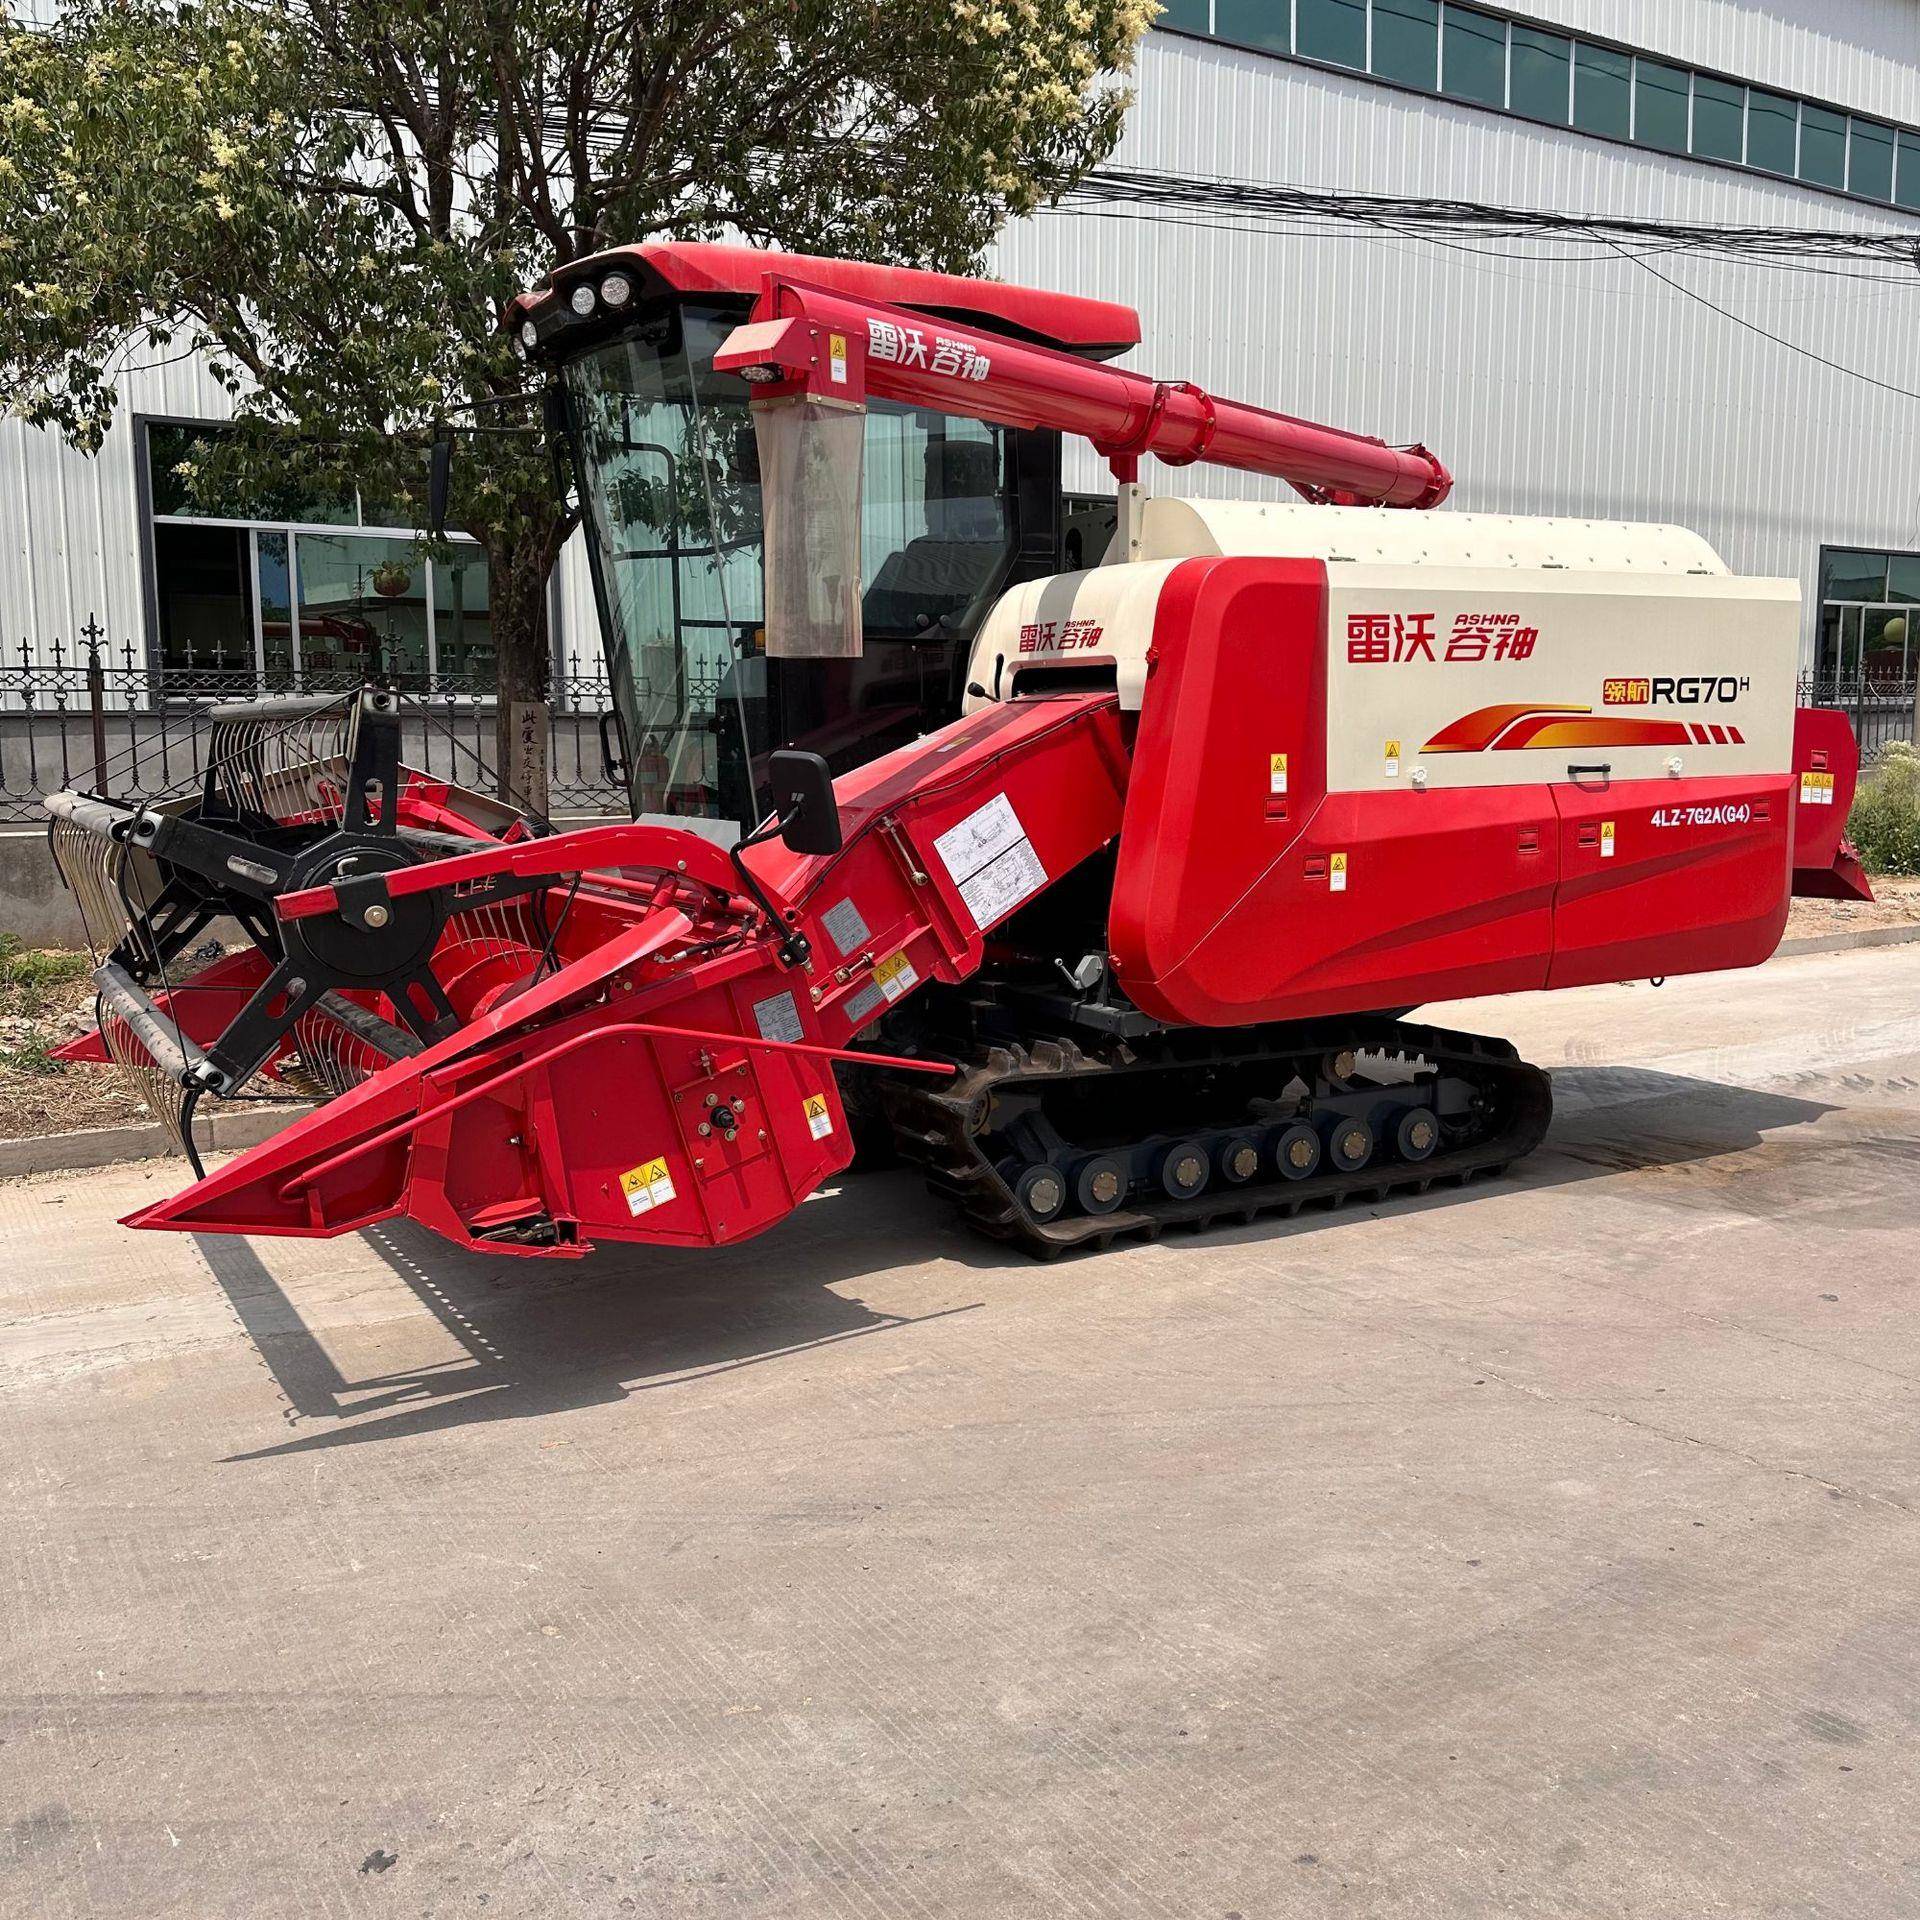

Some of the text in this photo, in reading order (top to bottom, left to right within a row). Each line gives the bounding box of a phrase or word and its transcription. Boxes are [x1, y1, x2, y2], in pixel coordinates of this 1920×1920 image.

[866, 317, 991, 381] 雷沃 谷神
[935, 336, 977, 353] ASHNA
[1064, 619, 1095, 628] ASHNA
[1454, 614, 1520, 625] ASHNA
[1019, 622, 1104, 653] 雷沃 谷神
[1347, 613, 1539, 663] 雷沃 谷神
[1604, 680, 1649, 703] 领航
[1650, 803, 1751, 828] 4LZ-7G2A(G4)
